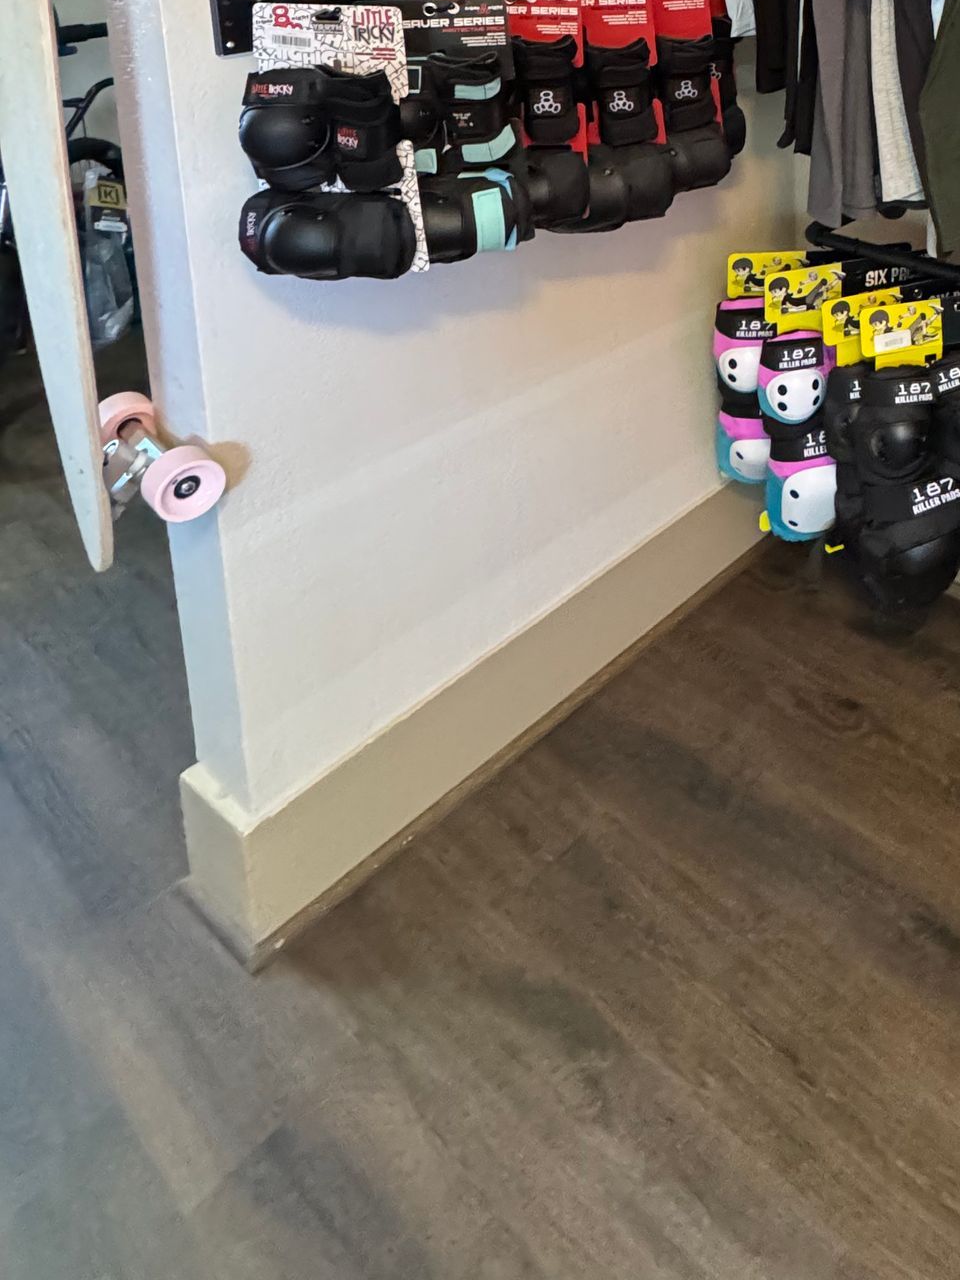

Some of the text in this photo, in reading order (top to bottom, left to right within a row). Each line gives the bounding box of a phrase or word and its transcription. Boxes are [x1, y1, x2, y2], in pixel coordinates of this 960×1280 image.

[353, 9, 395, 26] LITTLE
[531, 6, 578, 16] SERIES
[453, 16, 505, 26] SERIES
[352, 23, 396, 44] TRICKY
[865, 269, 888, 287] SIX
[735, 330, 757, 338] KILLER
[781, 347, 815, 361] 187
[778, 357, 817, 369] KILLER PADS
[898, 381, 931, 396] 187
[938, 378, 960, 393] KILLER
[894, 392, 933, 404] KILLER PADS
[912, 477, 954, 503] 187
[912, 496, 941, 516] KILLER
